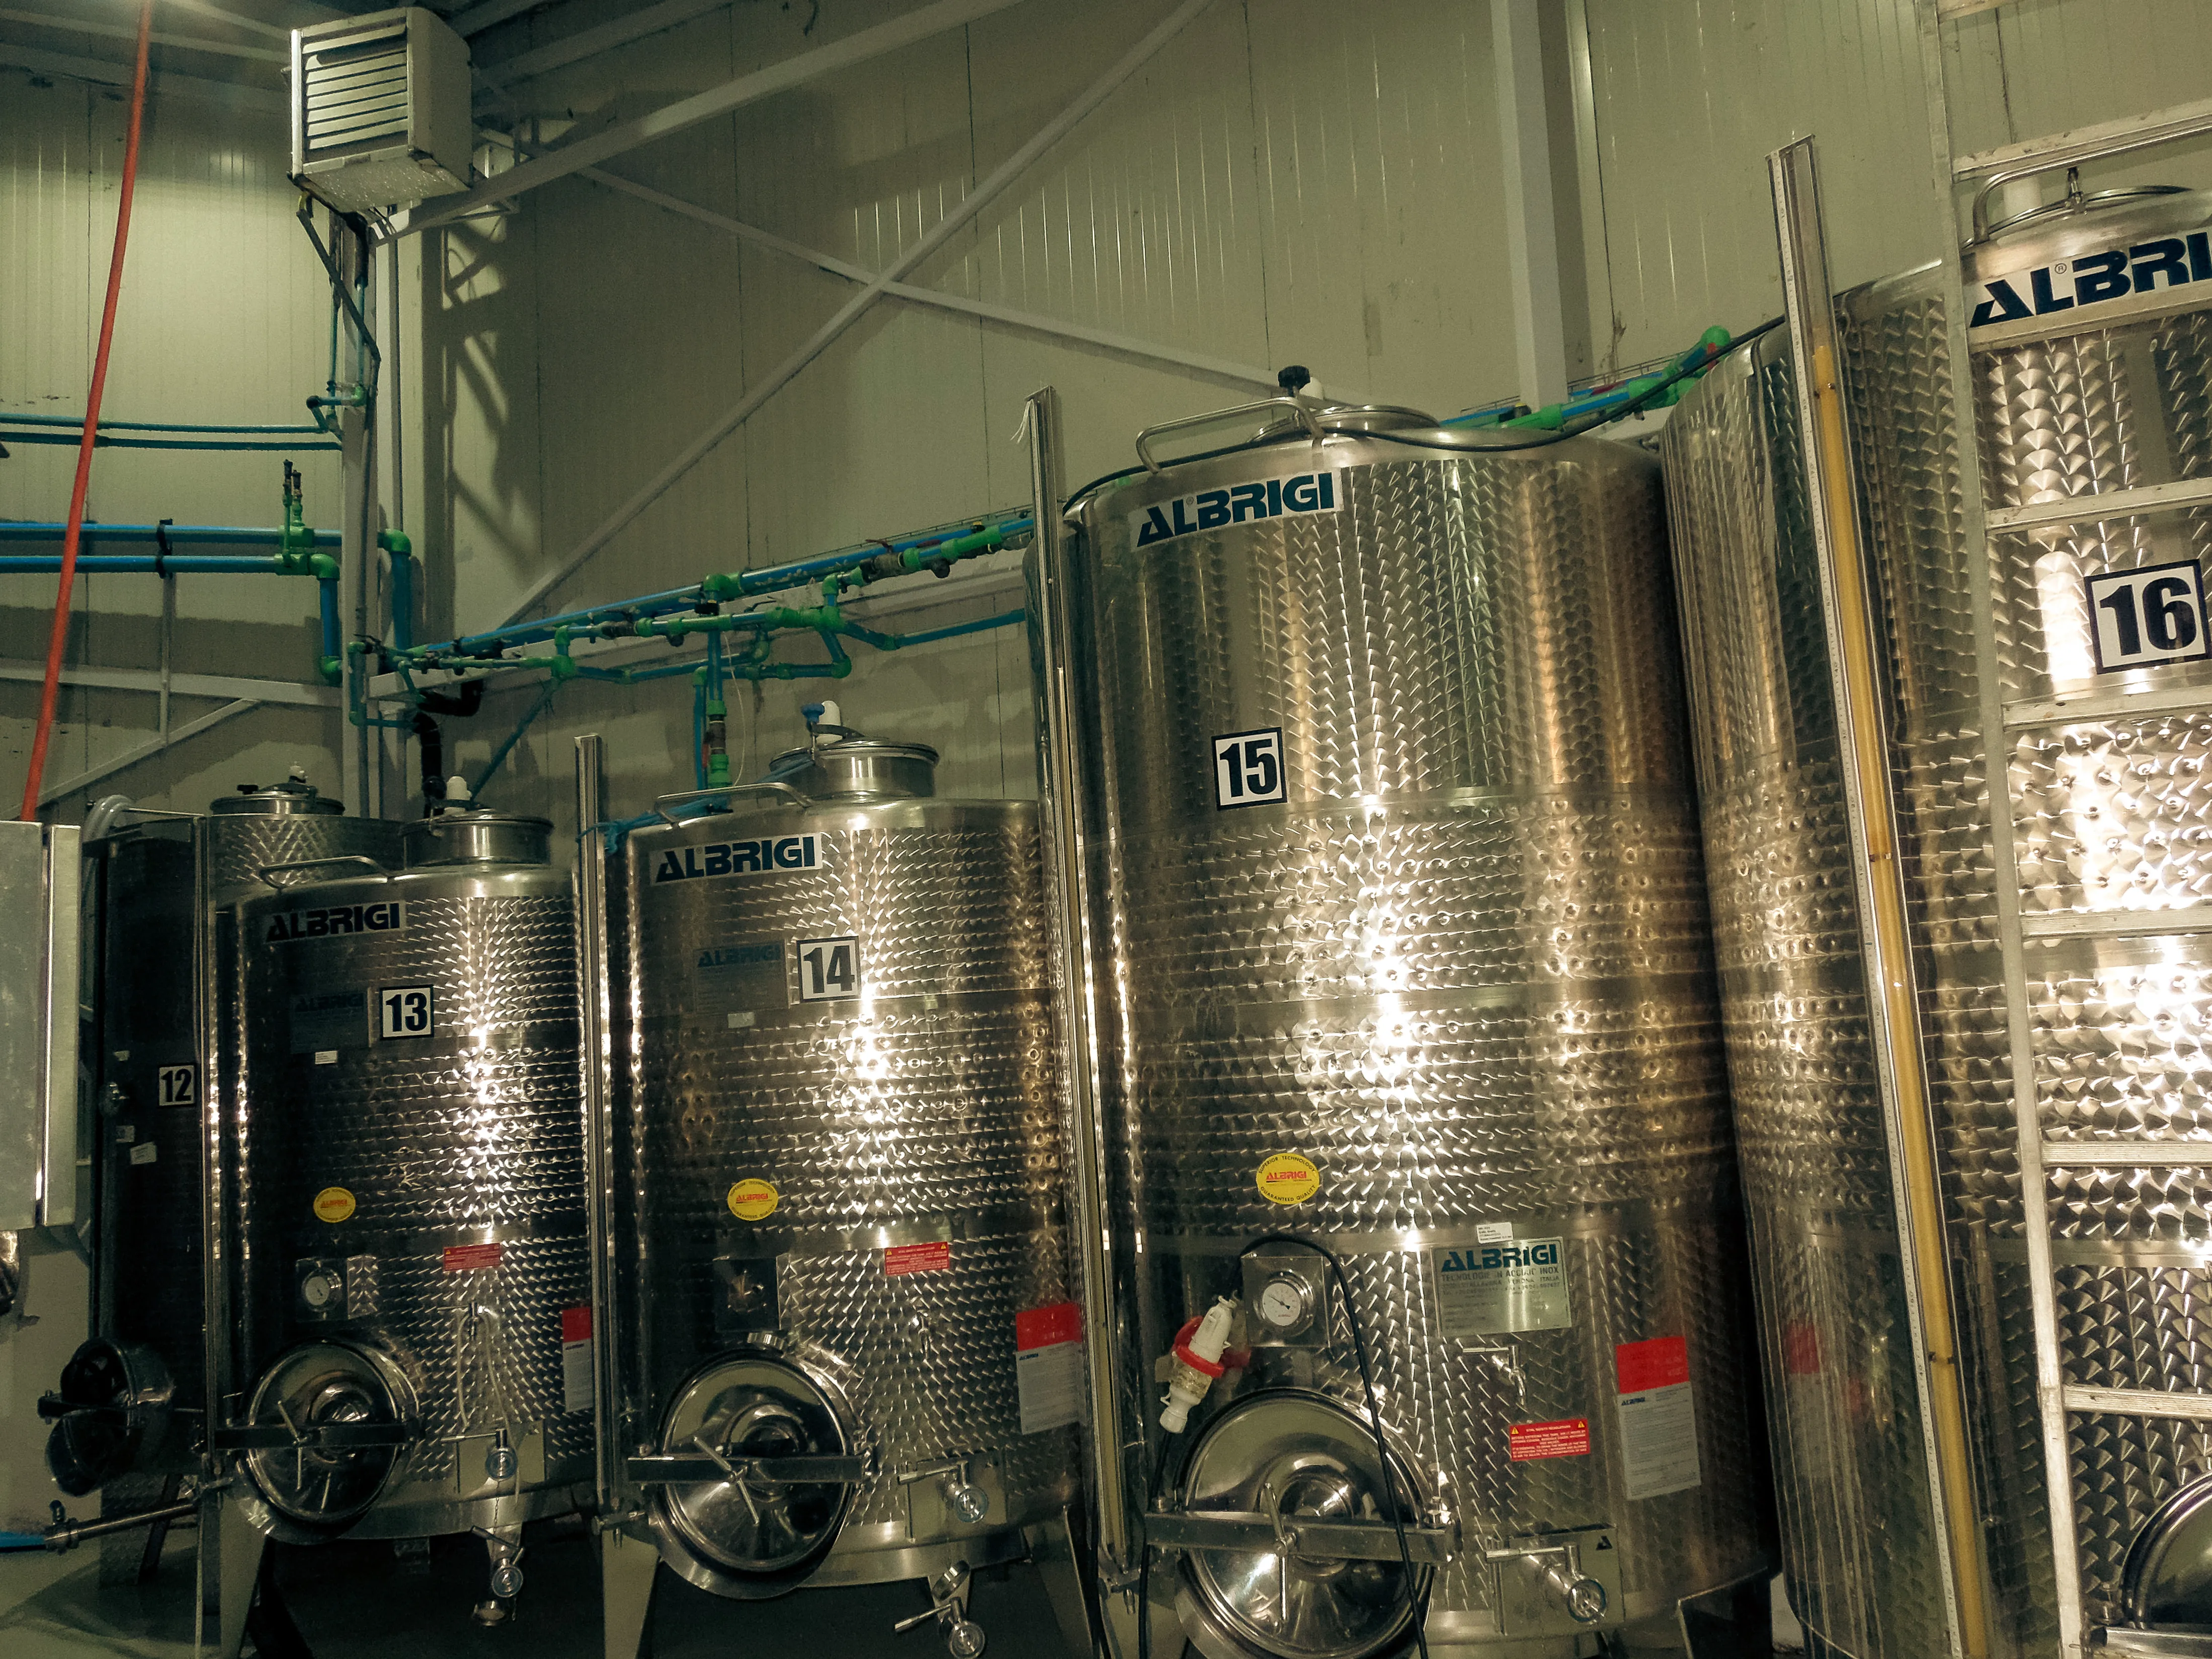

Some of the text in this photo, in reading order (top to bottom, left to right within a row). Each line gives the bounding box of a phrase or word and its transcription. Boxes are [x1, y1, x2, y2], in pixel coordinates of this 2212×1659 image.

[1970, 232, 2212, 328] ALBRI
[1136, 472, 1335, 547] ALBRIGI
[2100, 577, 2197, 656] 16
[1219, 739, 1278, 798] 15
[656, 836, 815, 883] ALBRIGI
[266, 903, 400, 942] ALBRIGI
[803, 945, 855, 994] 14
[385, 993, 428, 1032] 13
[162, 1069, 192, 1102] 12
[1266, 1171, 1306, 1180] ALBRIGI
[1282, 1156, 1316, 1172] TECHNOLOGY
[1296, 1185, 1316, 1200] QUALITY
[1441, 1244, 1558, 1273] ALBRIGI
[1540, 1266, 1559, 1275] INOX
